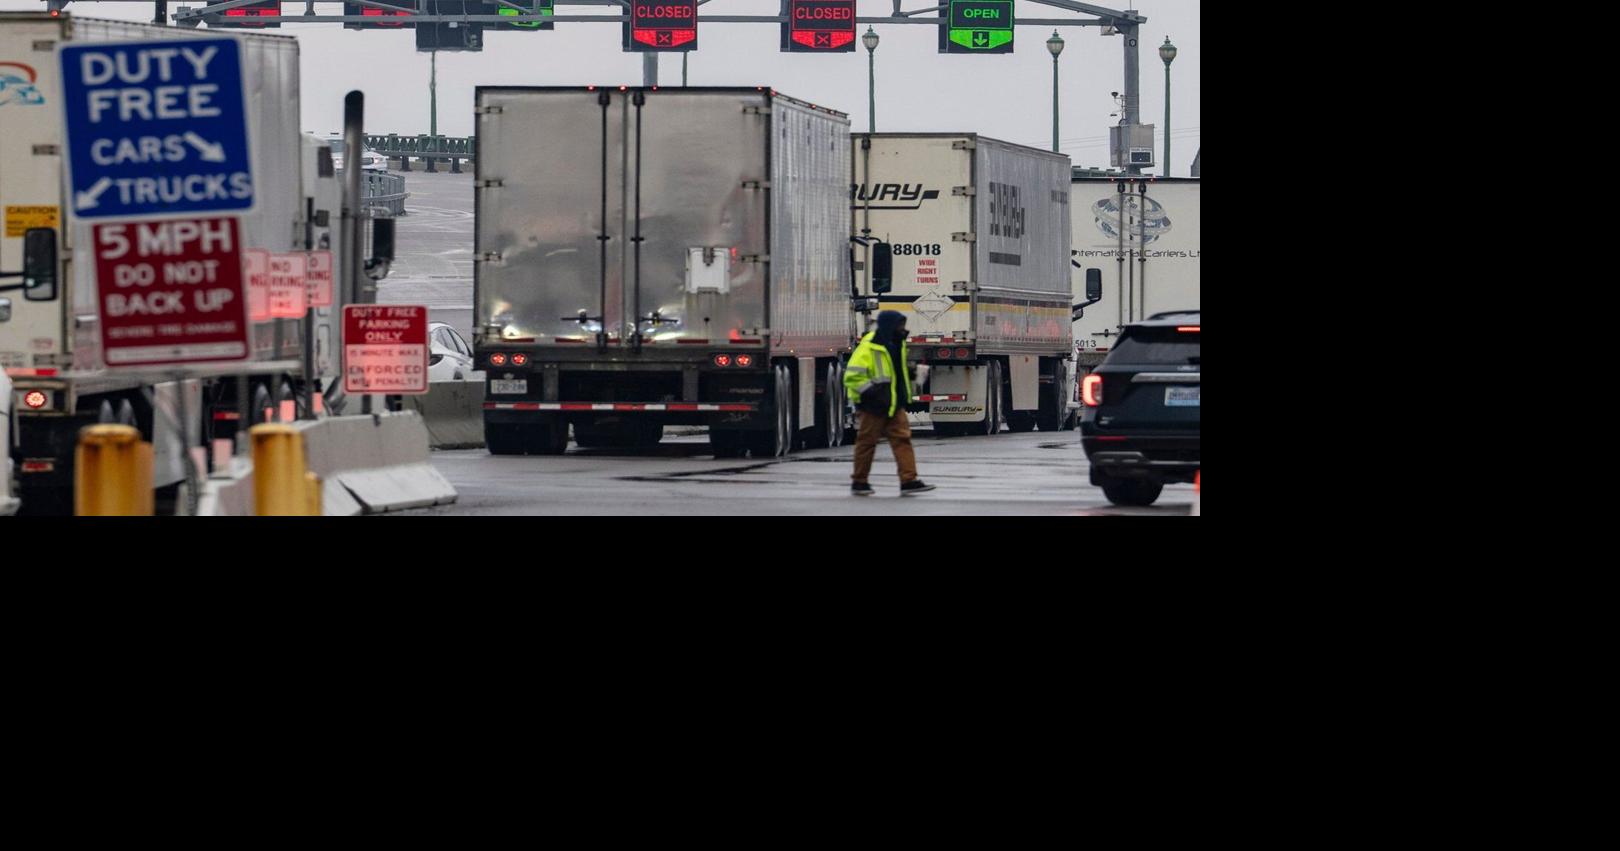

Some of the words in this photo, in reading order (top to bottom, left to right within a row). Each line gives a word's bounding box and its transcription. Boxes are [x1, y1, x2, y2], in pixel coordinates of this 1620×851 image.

[637, 6, 692, 18] CLOSED
[796, 7, 850, 20] CLOSED
[963, 8, 1000, 18] OPEN
[80, 46, 218, 86] DUTY
[87, 84, 221, 123] FREE
[91, 135, 187, 165] CARS
[116, 172, 252, 204] TRUCKS
[101, 224, 130, 259] 5
[136, 220, 233, 256] MPH
[893, 243, 941, 256] 88018
[1074, 249, 1141, 258] nternational
[1144, 249, 1187, 258] Carriers
[918, 259, 936, 267] WIDE
[114, 263, 154, 287] DO
[164, 260, 220, 285] NOT
[105, 291, 186, 317] BACK
[194, 288, 235, 312] UP
[351, 308, 382, 318] DUTY
[387, 308, 418, 317] FREE
[359, 319, 410, 329] PARKING
[365, 331, 403, 340] ONLY
[1075, 339, 1096, 347] 5013
[349, 364, 422, 375] ENFORCED
[375, 377, 419, 385] PENALTY
